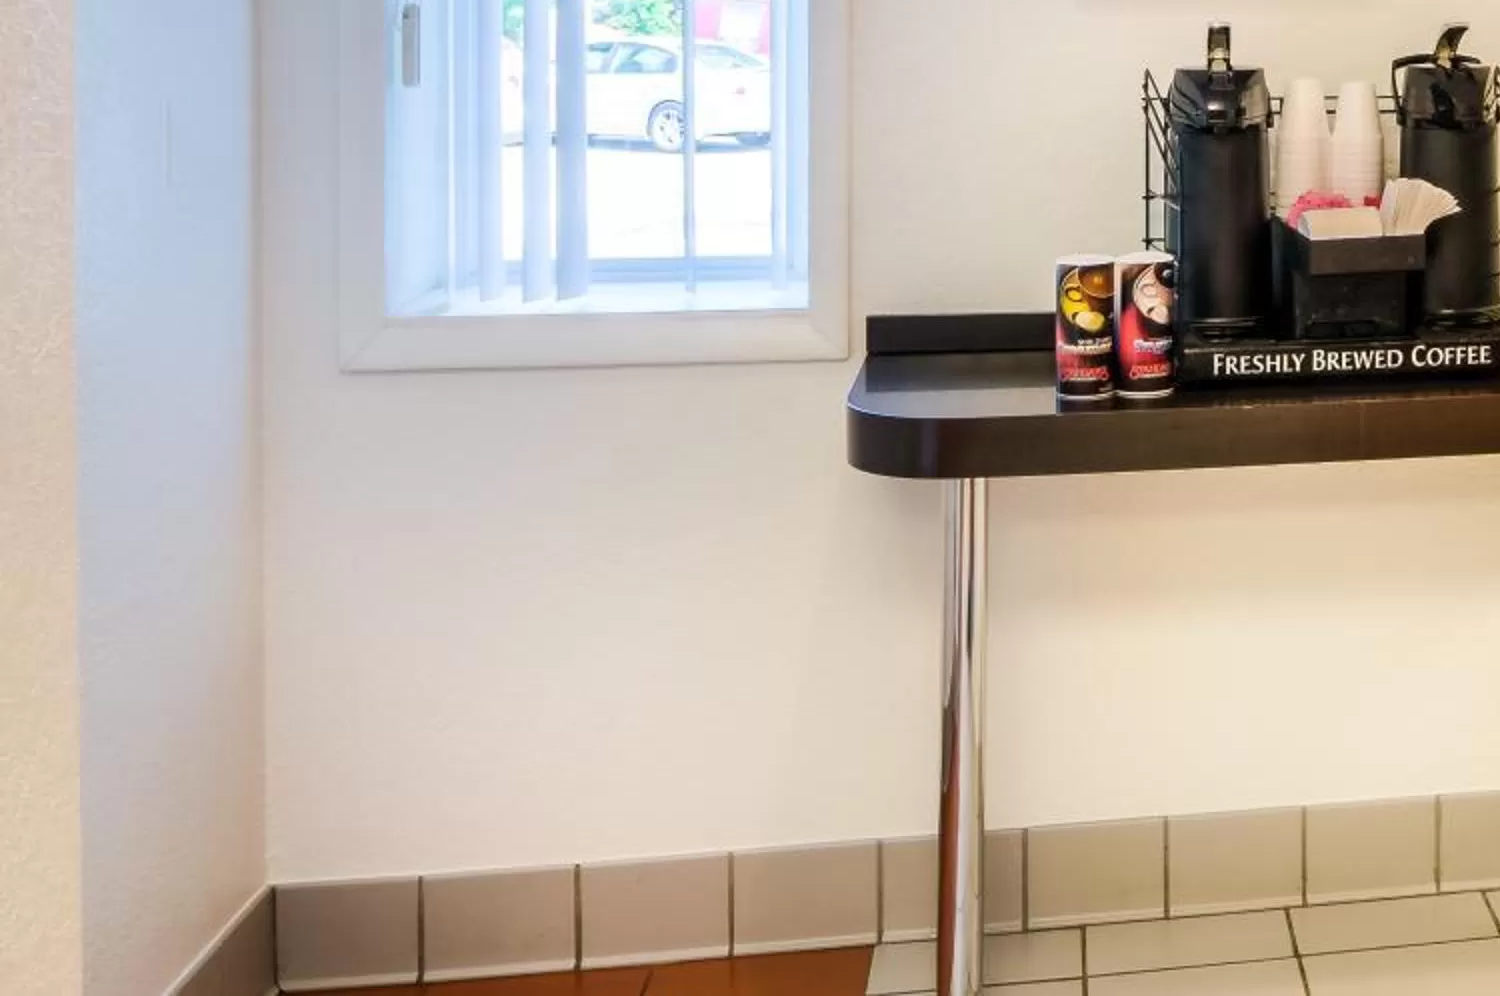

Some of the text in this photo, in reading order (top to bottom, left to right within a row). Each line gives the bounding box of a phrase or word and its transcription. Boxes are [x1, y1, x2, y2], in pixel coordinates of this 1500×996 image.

[1212, 344, 1493, 376] FRESHLY BREWED COFFEE
